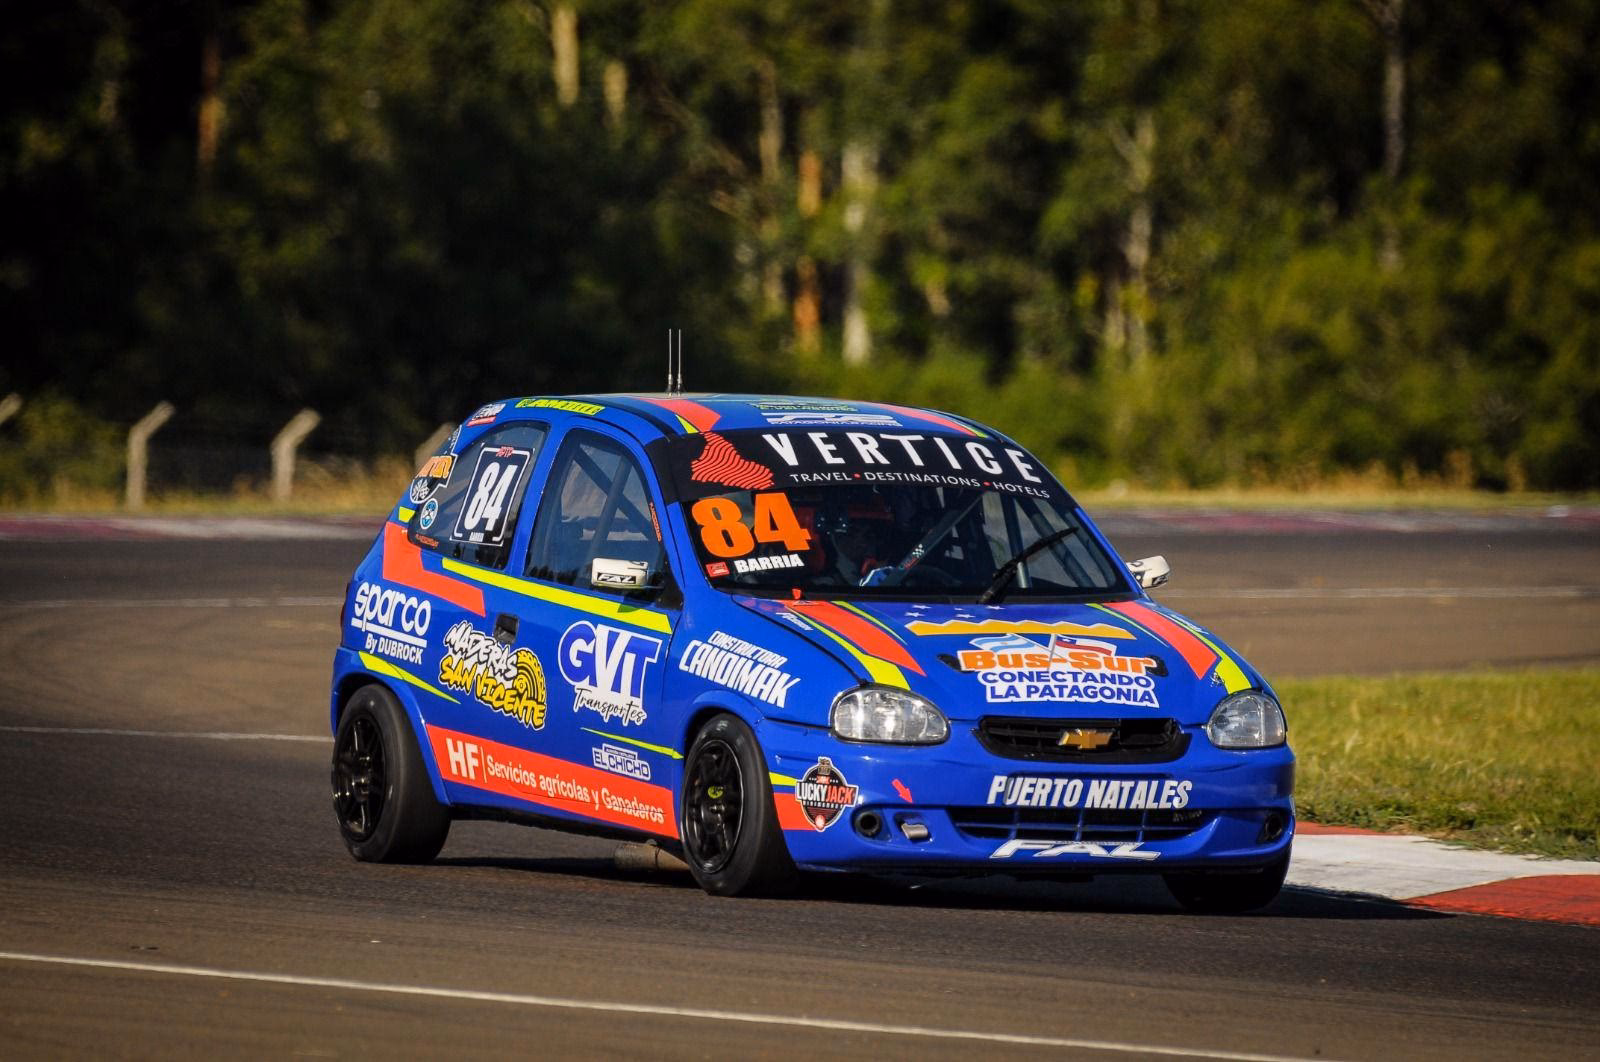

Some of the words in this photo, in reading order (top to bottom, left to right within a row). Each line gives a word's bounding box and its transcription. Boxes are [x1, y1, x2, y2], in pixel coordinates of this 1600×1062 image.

[762, 432, 1041, 483] VERTICE
[464, 461, 519, 531] 84
[790, 471, 852, 483] TRAVEL
[864, 471, 980, 487] DESTINATIONS
[992, 481, 1050, 499] HOTELS
[691, 492, 812, 558] 84
[734, 553, 805, 573] BARRIA
[354, 582, 431, 636] sparco
[365, 633, 378, 654] By
[378, 637, 423, 665] DUBROCK
[444, 621, 518, 680] MADERAS
[558, 620, 662, 699] GVT
[707, 630, 789, 669] CONSTRUCTORA
[958, 649, 1157, 674] Bus-Sur
[440, 655, 477, 695] SAN
[475, 667, 546, 729] VICENTE
[981, 671, 1151, 689] CONECTANDO
[990, 684, 1020, 699] LA
[1026, 684, 1155, 705] PATAGONIA
[575, 687, 646, 723] Transportes
[446, 737, 479, 780] HF
[486, 754, 537, 788] Servicios
[539, 773, 591, 803] agrícolas
[591, 789, 599, 811] y
[601, 787, 665, 824] Ganaderos
[594, 750, 608, 767] EL
[608, 754, 650, 778] CHICHO
[987, 775, 1084, 808] PUERTO
[1084, 780, 1193, 809] NATALES
[988, 838, 1162, 861] FAL
